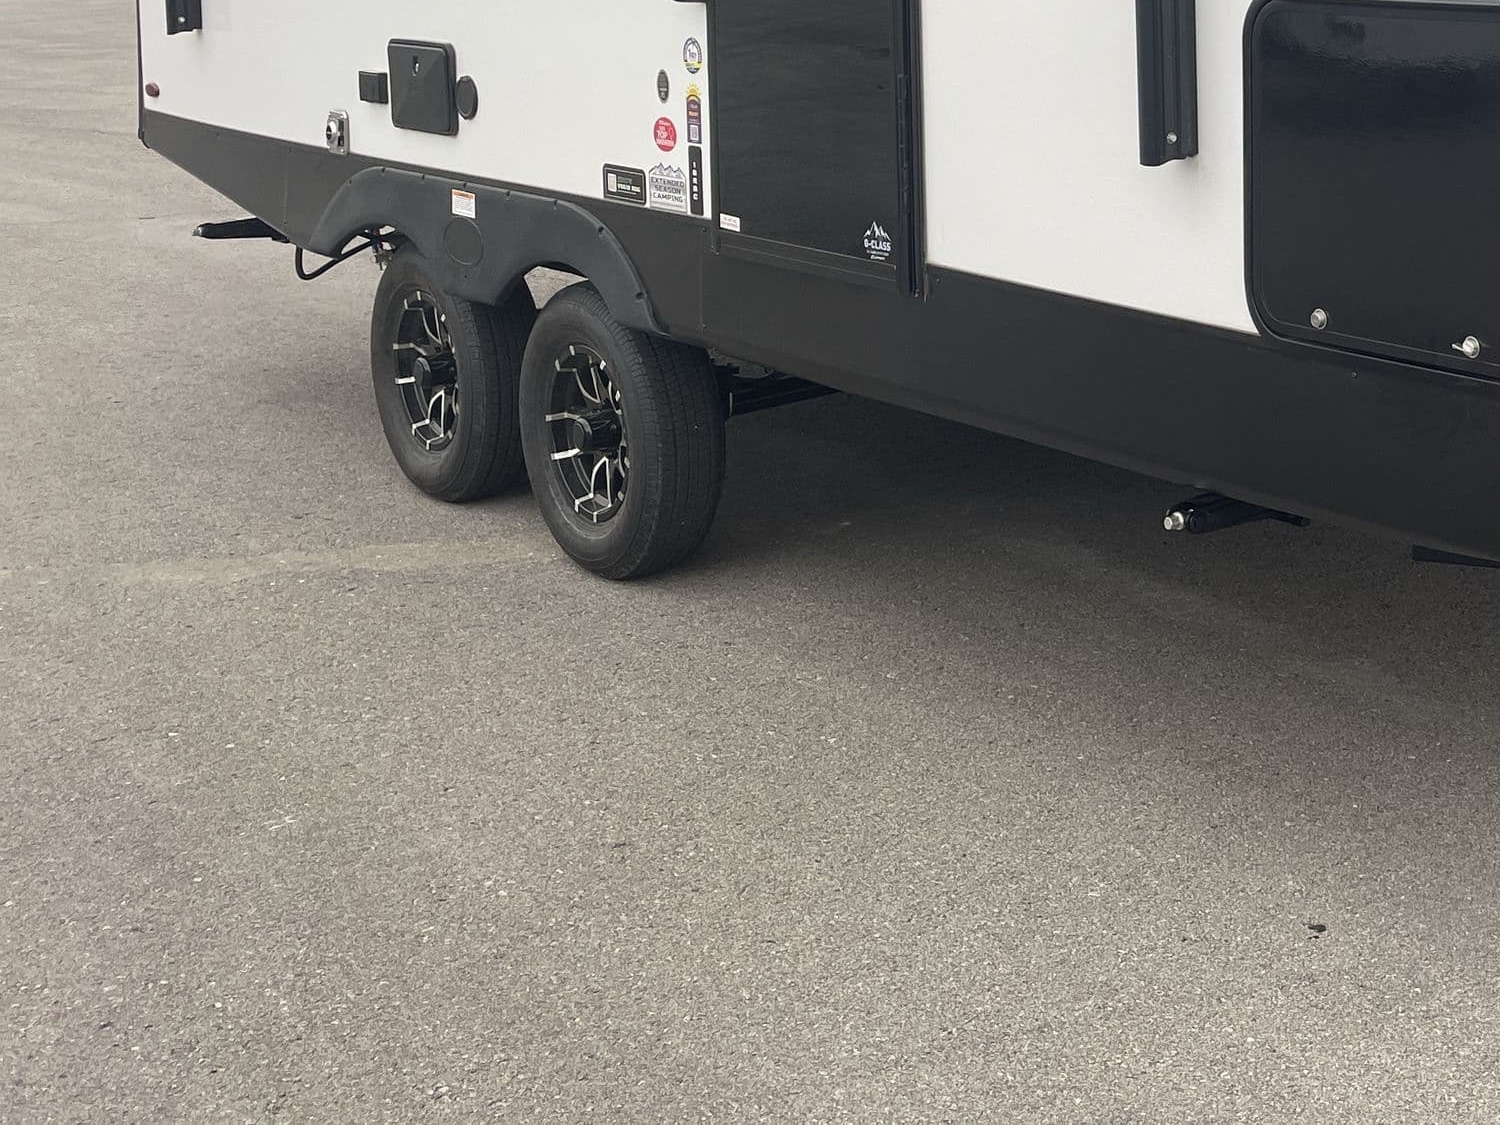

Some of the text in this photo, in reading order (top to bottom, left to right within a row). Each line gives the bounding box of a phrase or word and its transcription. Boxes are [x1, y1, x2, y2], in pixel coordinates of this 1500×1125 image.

[650, 176, 685, 188] EXTENDED
[654, 184, 681, 195] SEASON
[653, 192, 684, 203] CAMPING
[863, 238, 891, 252] G-CLASS
